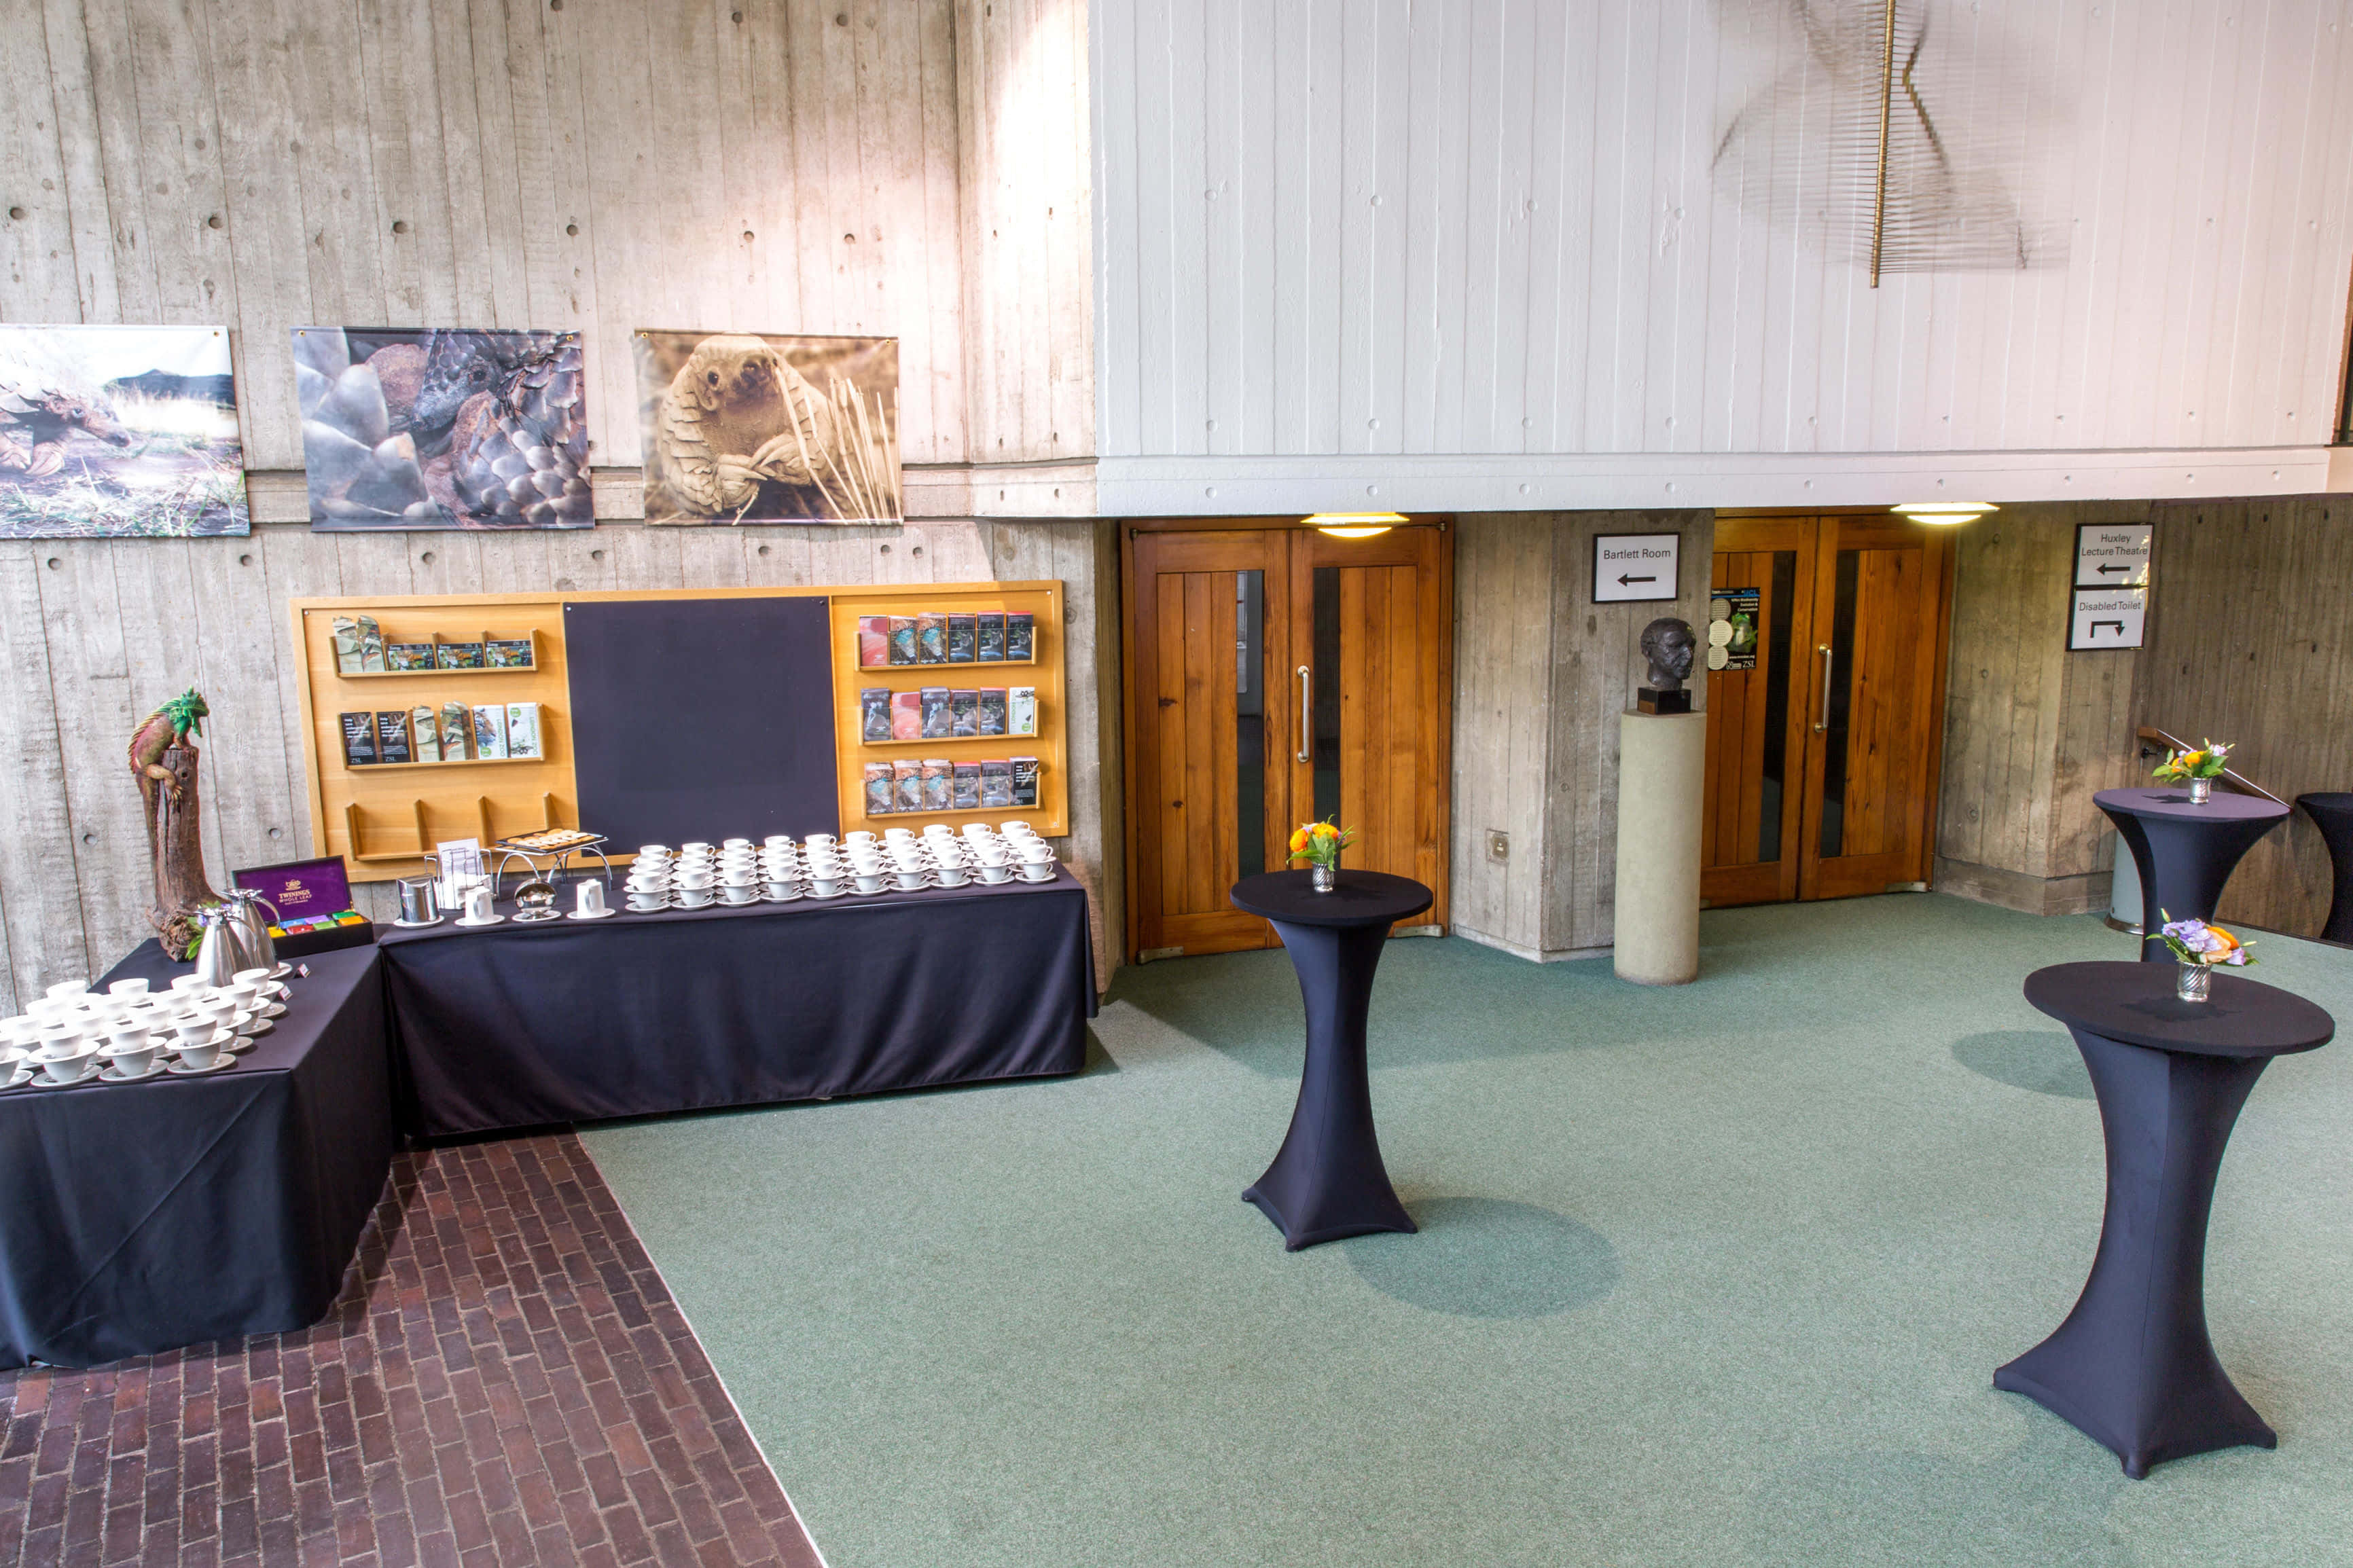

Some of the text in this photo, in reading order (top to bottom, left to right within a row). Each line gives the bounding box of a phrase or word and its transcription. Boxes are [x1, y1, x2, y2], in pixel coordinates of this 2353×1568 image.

[2101, 533, 2131, 543] Huxley
[1604, 549, 1671, 560] Bartlett Room
[2081, 547, 2148, 556] Lecture Theatre
[2079, 601, 2141, 611] Disabled Toilet
[1743, 660, 1755, 668] ZSL
[278, 889, 310, 899] TWININGS
